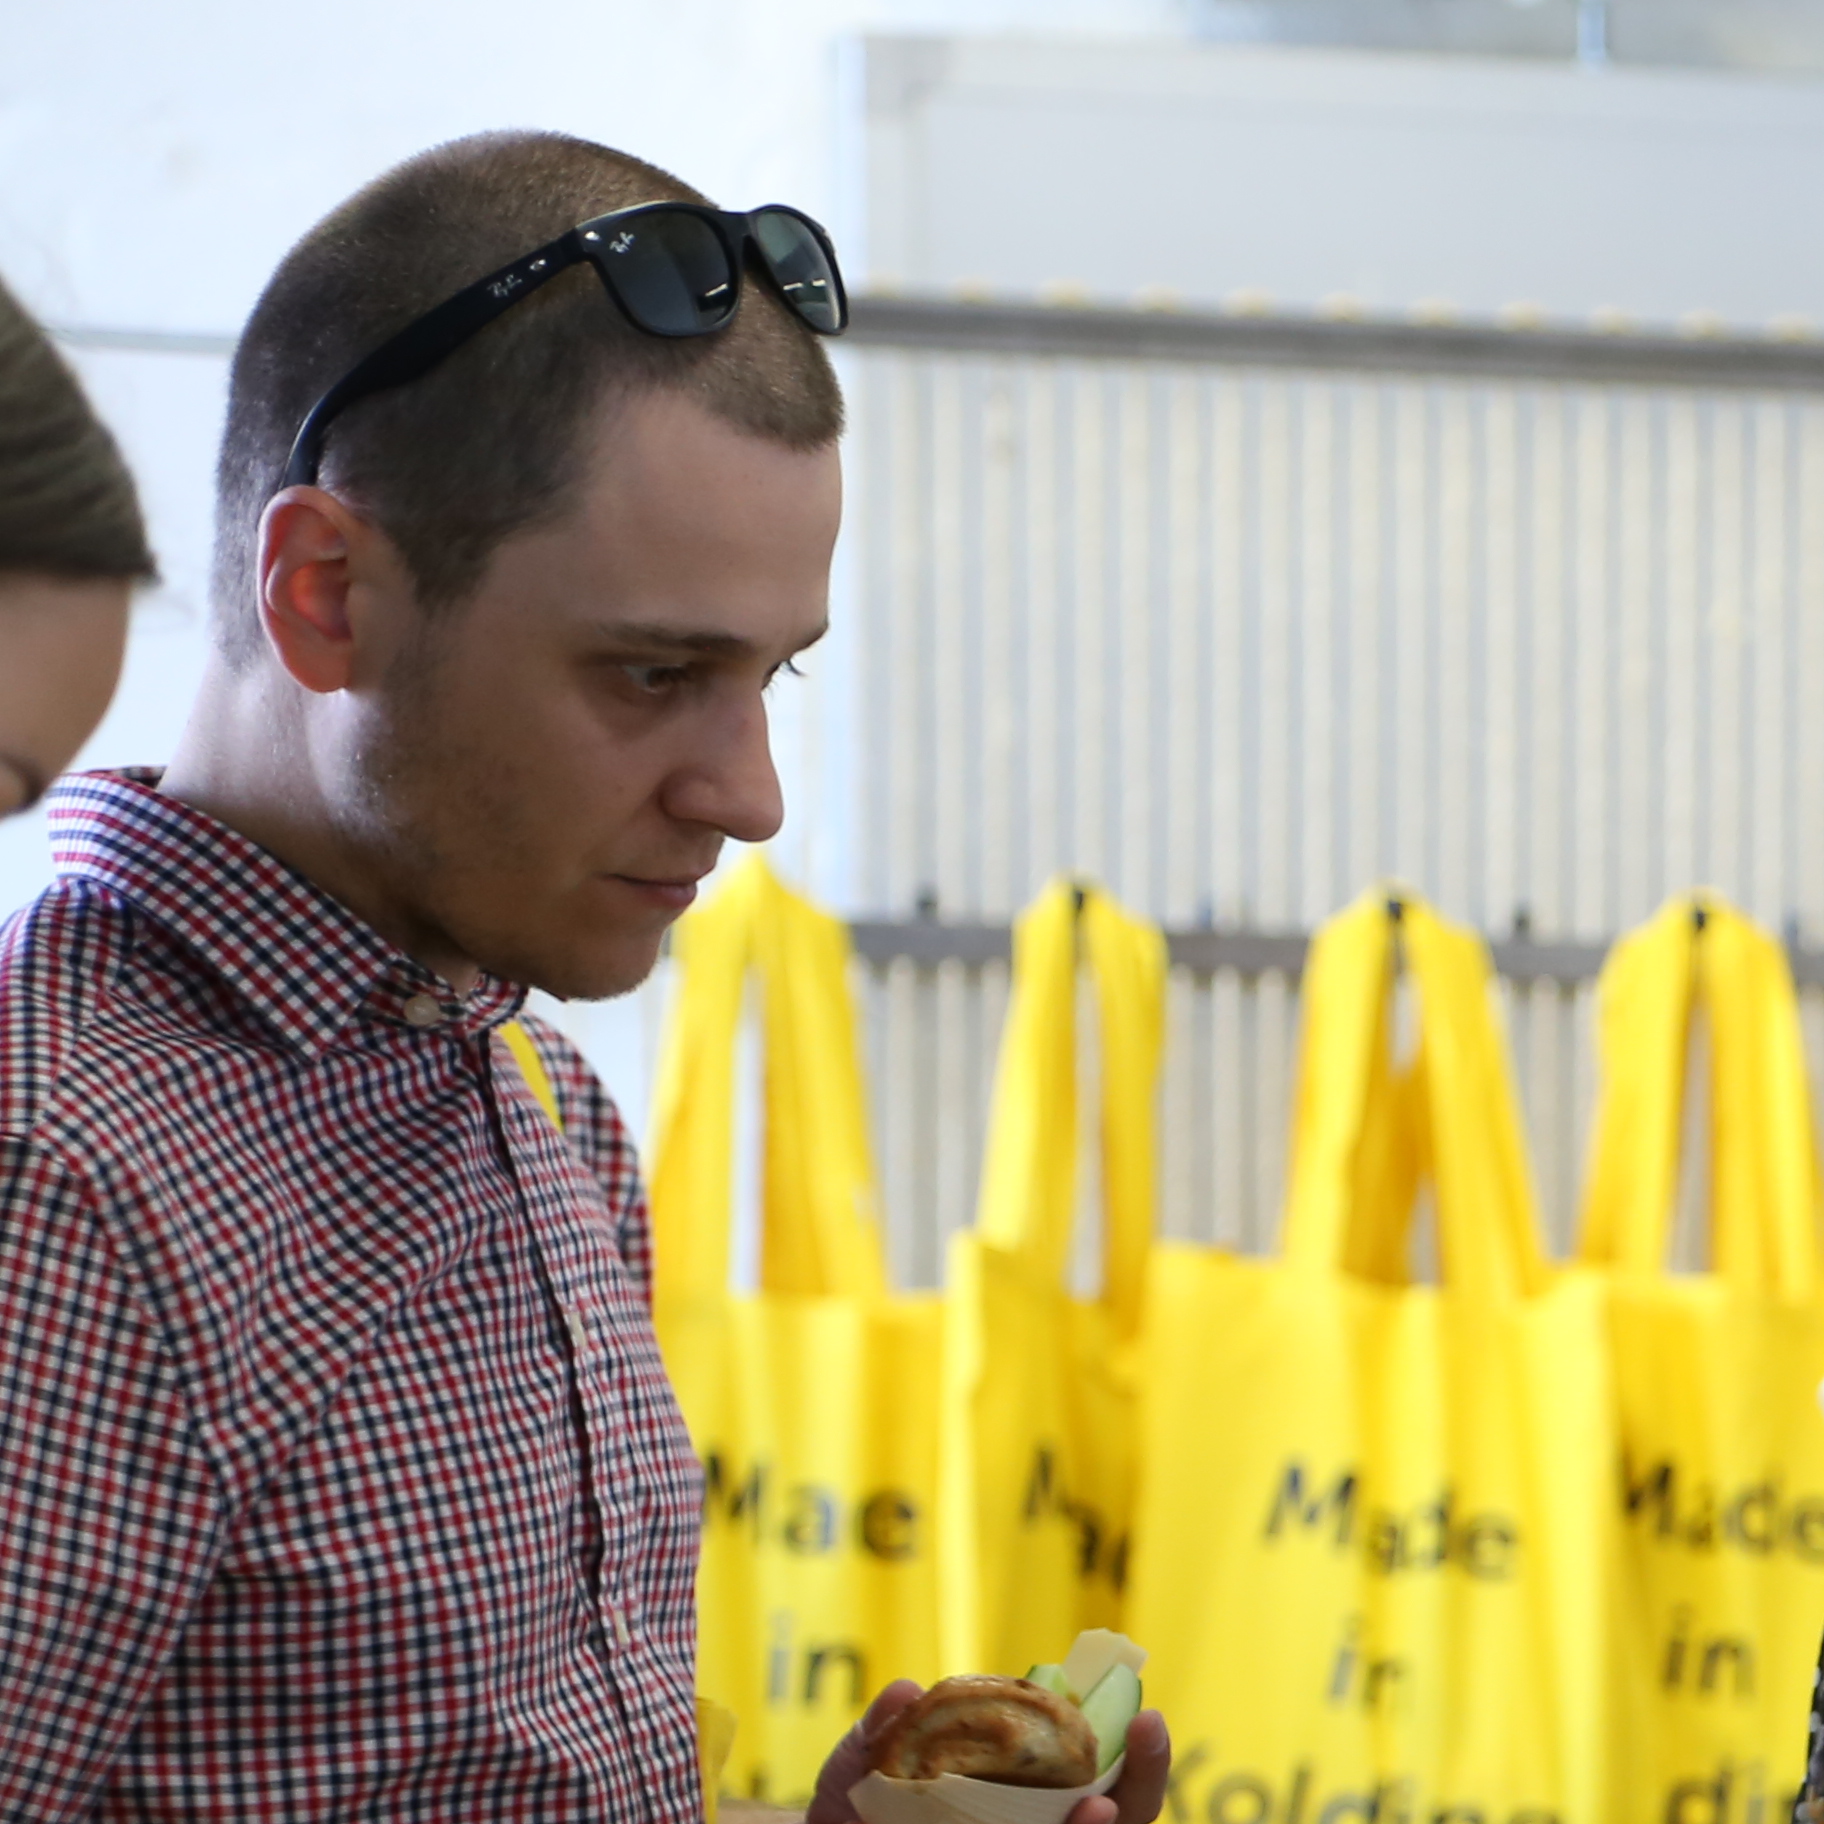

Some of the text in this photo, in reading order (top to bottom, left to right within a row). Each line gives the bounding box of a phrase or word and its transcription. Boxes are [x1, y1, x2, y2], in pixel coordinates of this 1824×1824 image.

[700, 1450, 917, 1562] Mae
[1264, 1455, 1518, 1582] Made
[767, 1612, 864, 1704] in
[1662, 1603, 1757, 1698] in
